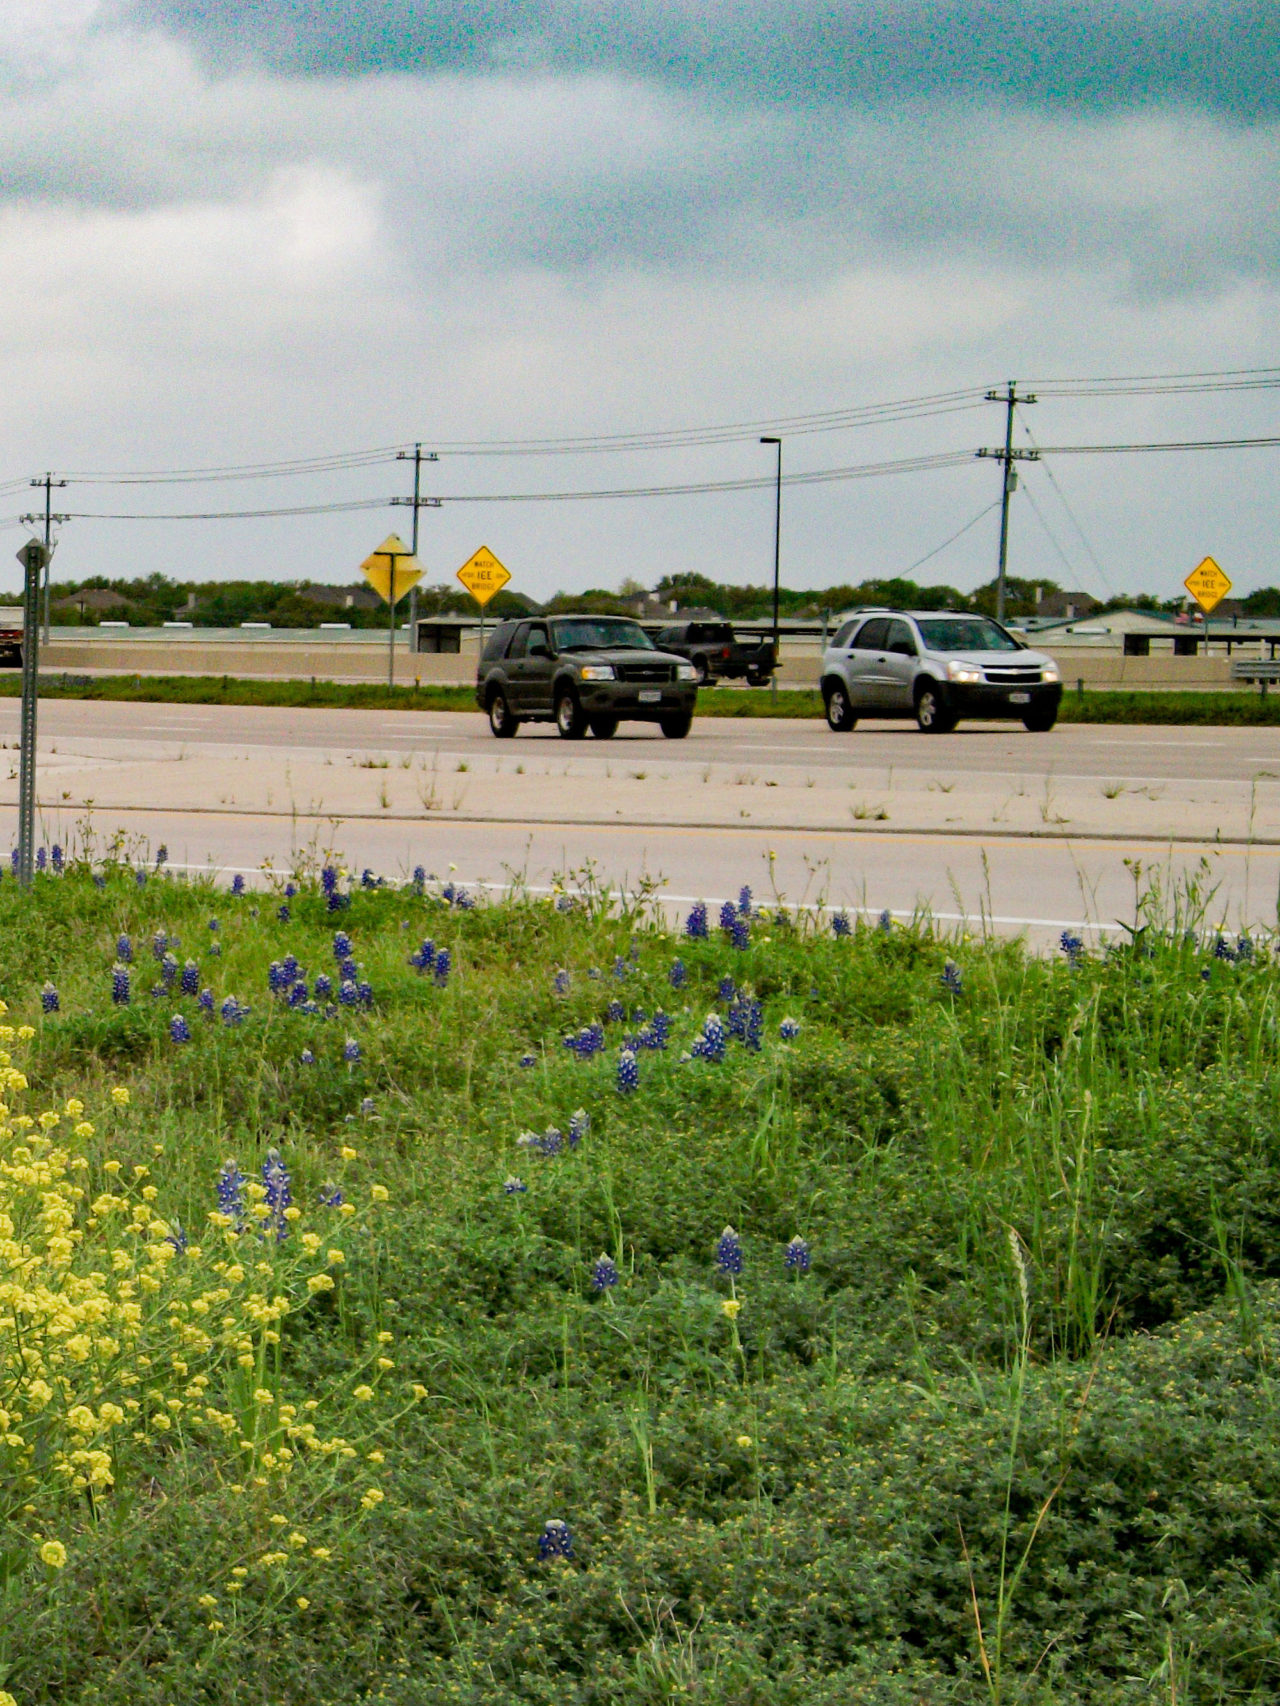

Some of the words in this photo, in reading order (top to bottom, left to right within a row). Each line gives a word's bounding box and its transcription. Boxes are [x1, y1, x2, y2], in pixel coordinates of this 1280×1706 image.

[474, 560, 494, 568] WATCH
[477, 571, 492, 580] ICE
[472, 582, 495, 590] BRIDGE
[1202, 580, 1216, 589] ICE
